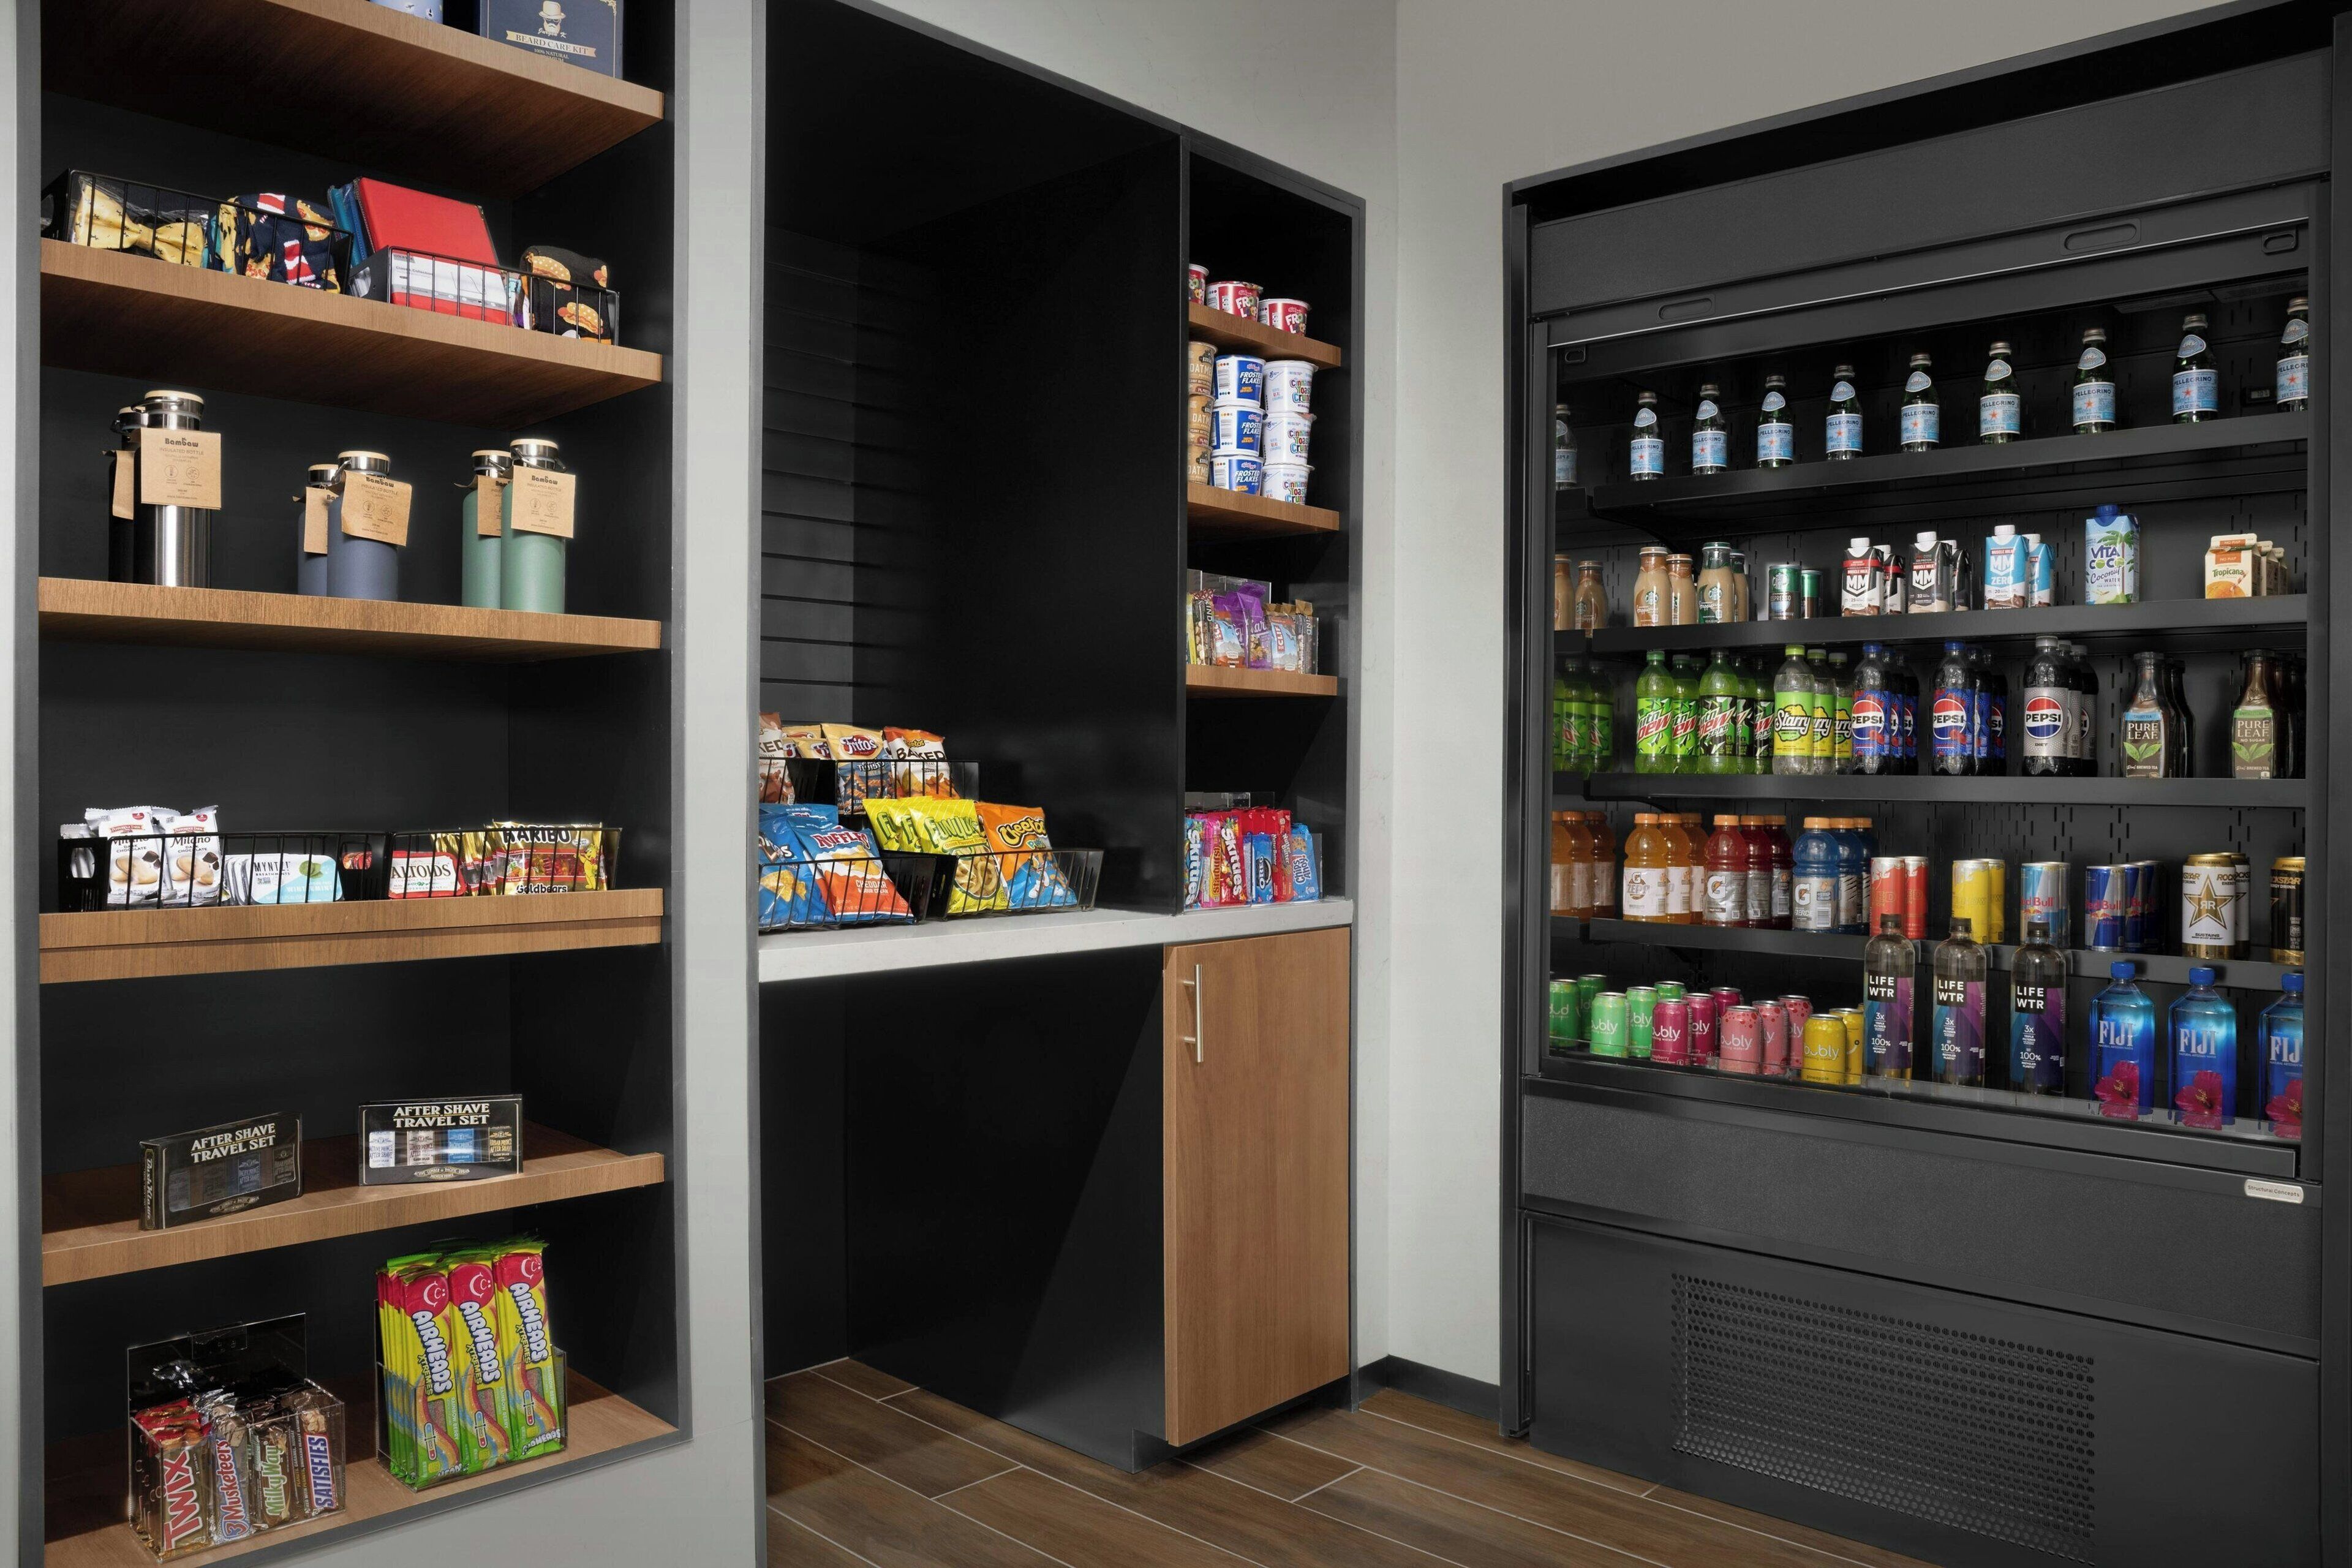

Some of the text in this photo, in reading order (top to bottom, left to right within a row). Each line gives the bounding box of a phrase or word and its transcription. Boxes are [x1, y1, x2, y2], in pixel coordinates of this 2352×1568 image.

[515, 34, 588, 55] BEARD CARE KIT
[546, 50, 569, 59] NATURAL
[2278, 363, 2309, 373] PELLEGRI
[165, 437, 198, 447] Bambaw
[366, 477, 394, 488] Bambaw
[532, 475, 559, 485] Bambaw
[2090, 545, 2120, 559] VITA
[2212, 568, 2244, 578] Tropicana
[1775, 709, 1812, 736] Starry
[1852, 714, 1883, 724] PEPSI
[1933, 714, 1966, 723] PEPSI
[2026, 713, 2061, 723] PEPSI
[2237, 720, 2270, 728] PURE
[2128, 723, 2158, 731] PURE
[2237, 729, 2269, 737] LEAF
[759, 739, 783, 753] KED
[840, 735, 877, 755] Fritos
[896, 747, 945, 760] BAKED
[500, 824, 571, 844] HARIBO
[810, 831, 870, 850] RUFFLES
[855, 880, 888, 889] CHEDDAR
[2033, 897, 2054, 907] Bull
[2101, 899, 2123, 910] Bull
[1869, 975, 1894, 986] LIFE
[1938, 979, 1964, 990] LIFE
[1869, 987, 1894, 998] WTR
[1938, 991, 1964, 1003] WTR
[2017, 986, 2045, 997] LIFE
[2017, 998, 2045, 1009] WTR
[1591, 1019, 1618, 1035] ubly
[2098, 1020, 2134, 1047] FIJI
[1941, 1044, 1961, 1052] 100%
[2179, 1027, 2216, 1055] FIJI
[1804, 1044, 1840, 1060] bubly
[2269, 1035, 2303, 1063] FIJ
[2020, 1052, 2041, 1061] 100%
[393, 1103, 489, 1117] AFTER SHAVE
[393, 1114, 489, 1128] TRAVEL SET
[191, 1123, 276, 1152] AFTER SHAVE
[190, 1135, 276, 1163] TRAVEL SET
[2247, 1184, 2301, 1198] Structural Concepts
[510, 1282, 549, 1363] AIRHEADS
[459, 1300, 501, 1384] AIRHEADS
[515, 1324, 531, 1365] XTREMES
[412, 1310, 453, 1393] AIRHEADS
[466, 1344, 482, 1385] XTREMES
[418, 1354, 434, 1397] XTREMES
[307, 1436, 334, 1507] SATISFIES
[216, 1439, 244, 1521] Musketeers
[164, 1450, 203, 1550] TWIX
